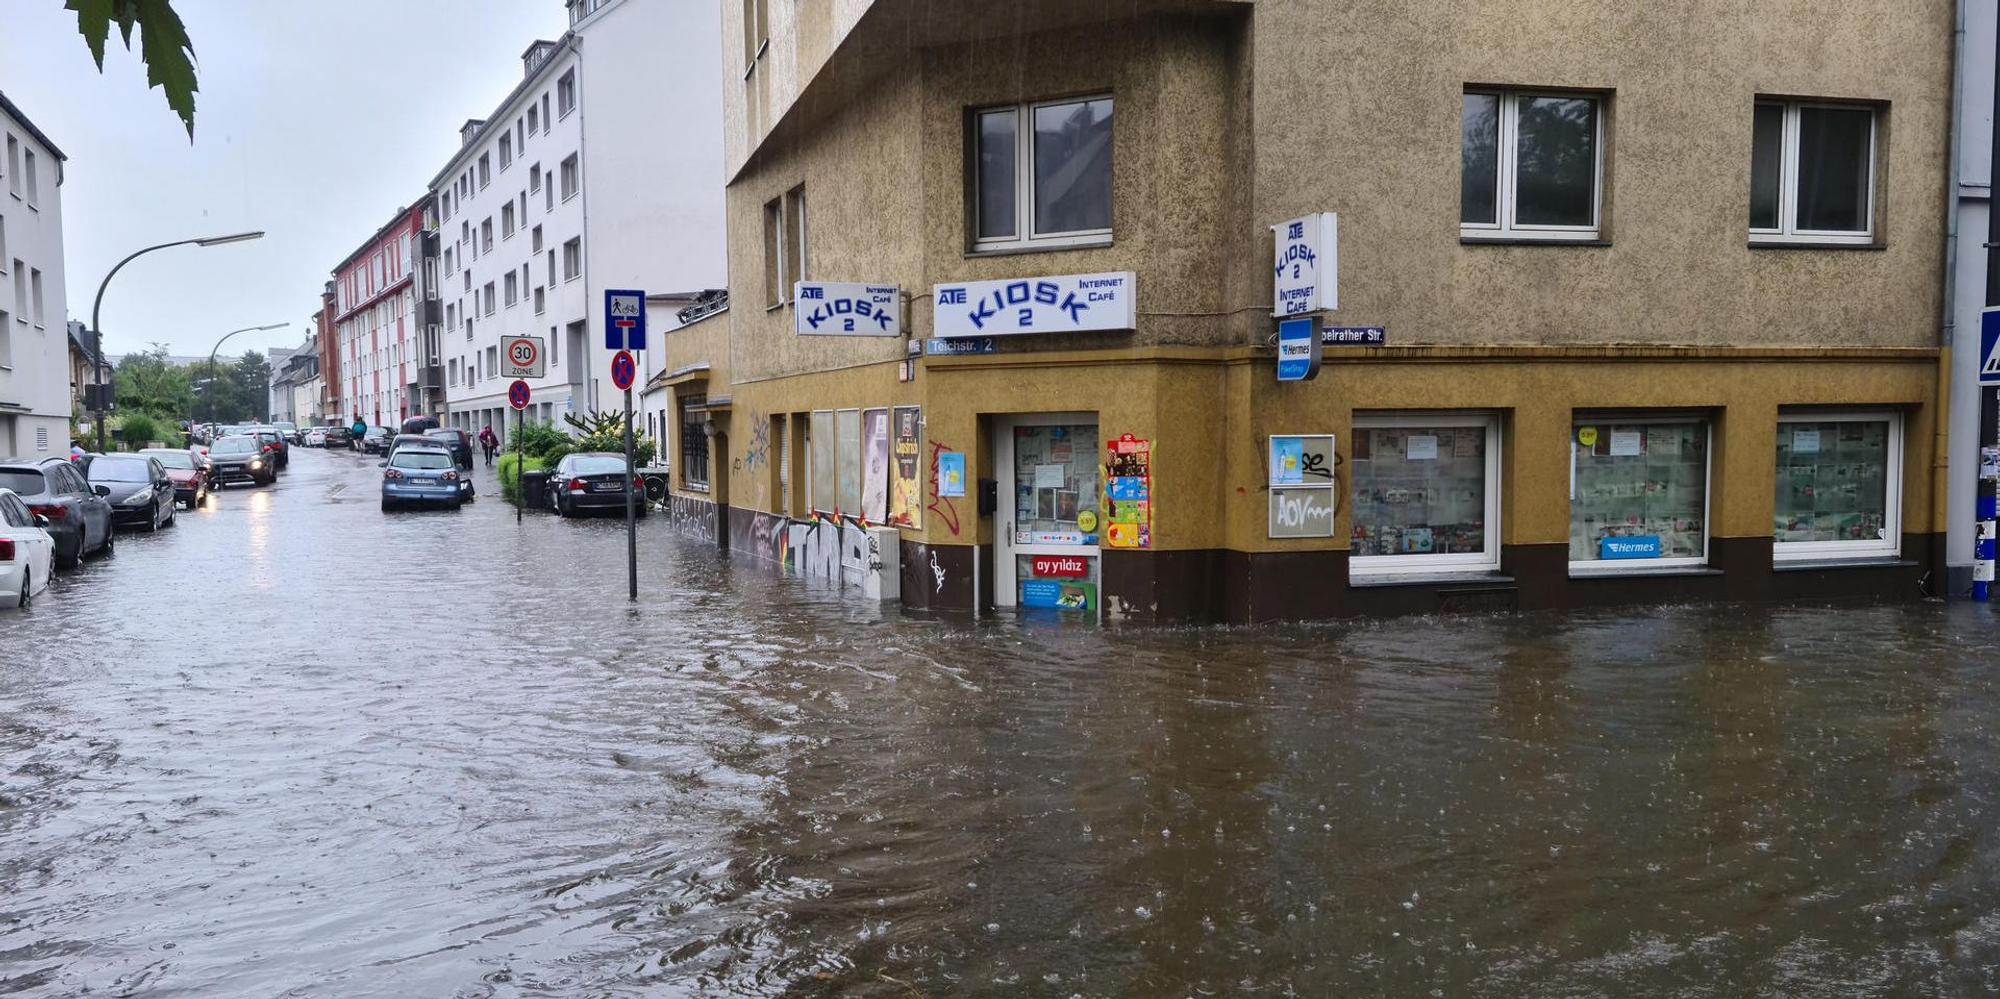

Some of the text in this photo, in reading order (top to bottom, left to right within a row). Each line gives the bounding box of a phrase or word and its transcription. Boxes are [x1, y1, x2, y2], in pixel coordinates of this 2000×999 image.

[1288, 221, 1304, 241] ATE
[1276, 244, 1316, 278] KIOSK
[1293, 263, 1300, 279] 2
[866, 286, 897, 295] INTERNET
[1079, 278, 1124, 290] INTERNET
[800, 287, 824, 300] ATE
[938, 288, 967, 305] ATE
[1280, 286, 1314, 301] INTERNET
[968, 280, 1090, 329] KIOSK
[806, 298, 894, 332] KIOSK
[1019, 307, 1033, 327] 2
[844, 318, 855, 332] 2
[1367, 329, 1383, 341] Str.
[931, 340, 977, 352] Teichstr.
[984, 338, 993, 352] 2
[1288, 344, 1310, 355] Hermes
[514, 346, 531, 360] 30
[512, 367, 533, 375] ZONE
[1618, 542, 1655, 552] Hermes
[1037, 561, 1050, 573] ay
